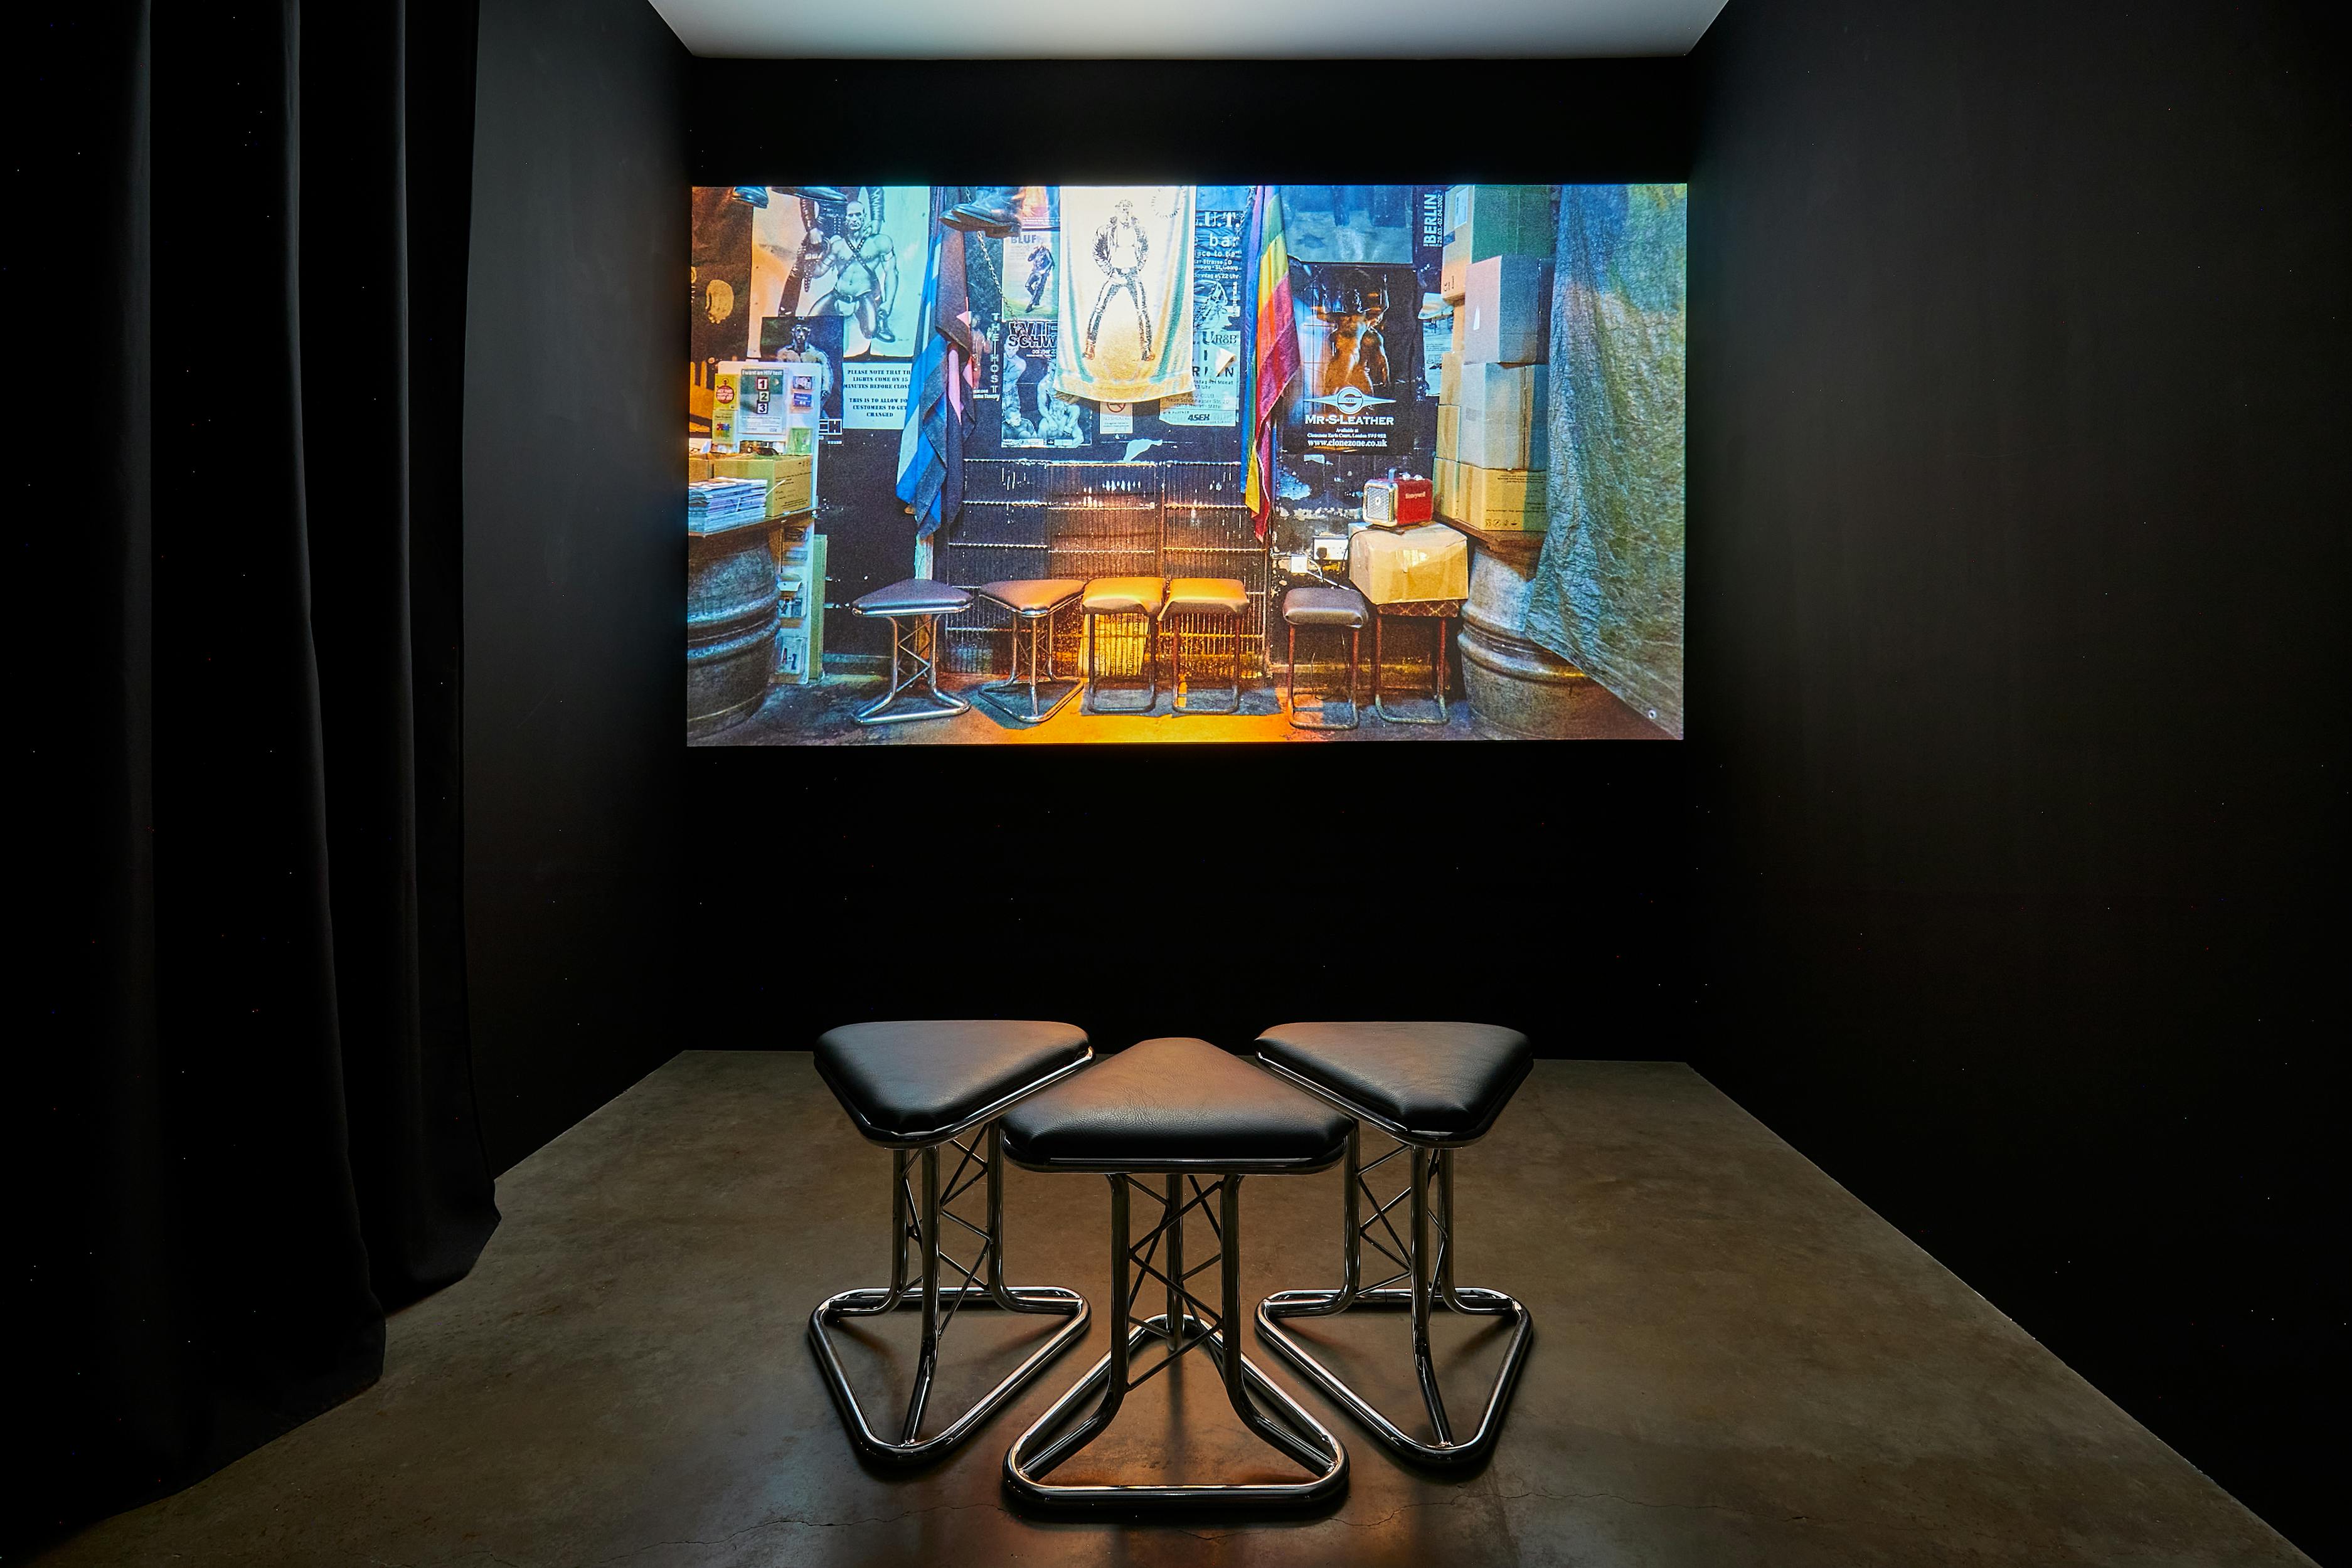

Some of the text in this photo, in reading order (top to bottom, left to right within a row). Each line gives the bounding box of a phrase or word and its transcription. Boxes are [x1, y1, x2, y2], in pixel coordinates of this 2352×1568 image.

[1423, 194, 1437, 243] BERLIN
[1011, 235, 1036, 244] BLUF
[1210, 233, 1240, 247] bar
[759, 379, 765, 389] 1
[760, 393, 768, 401] 2
[758, 404, 766, 413] 3
[1307, 438, 1388, 447] www.clonezone.co.uk
